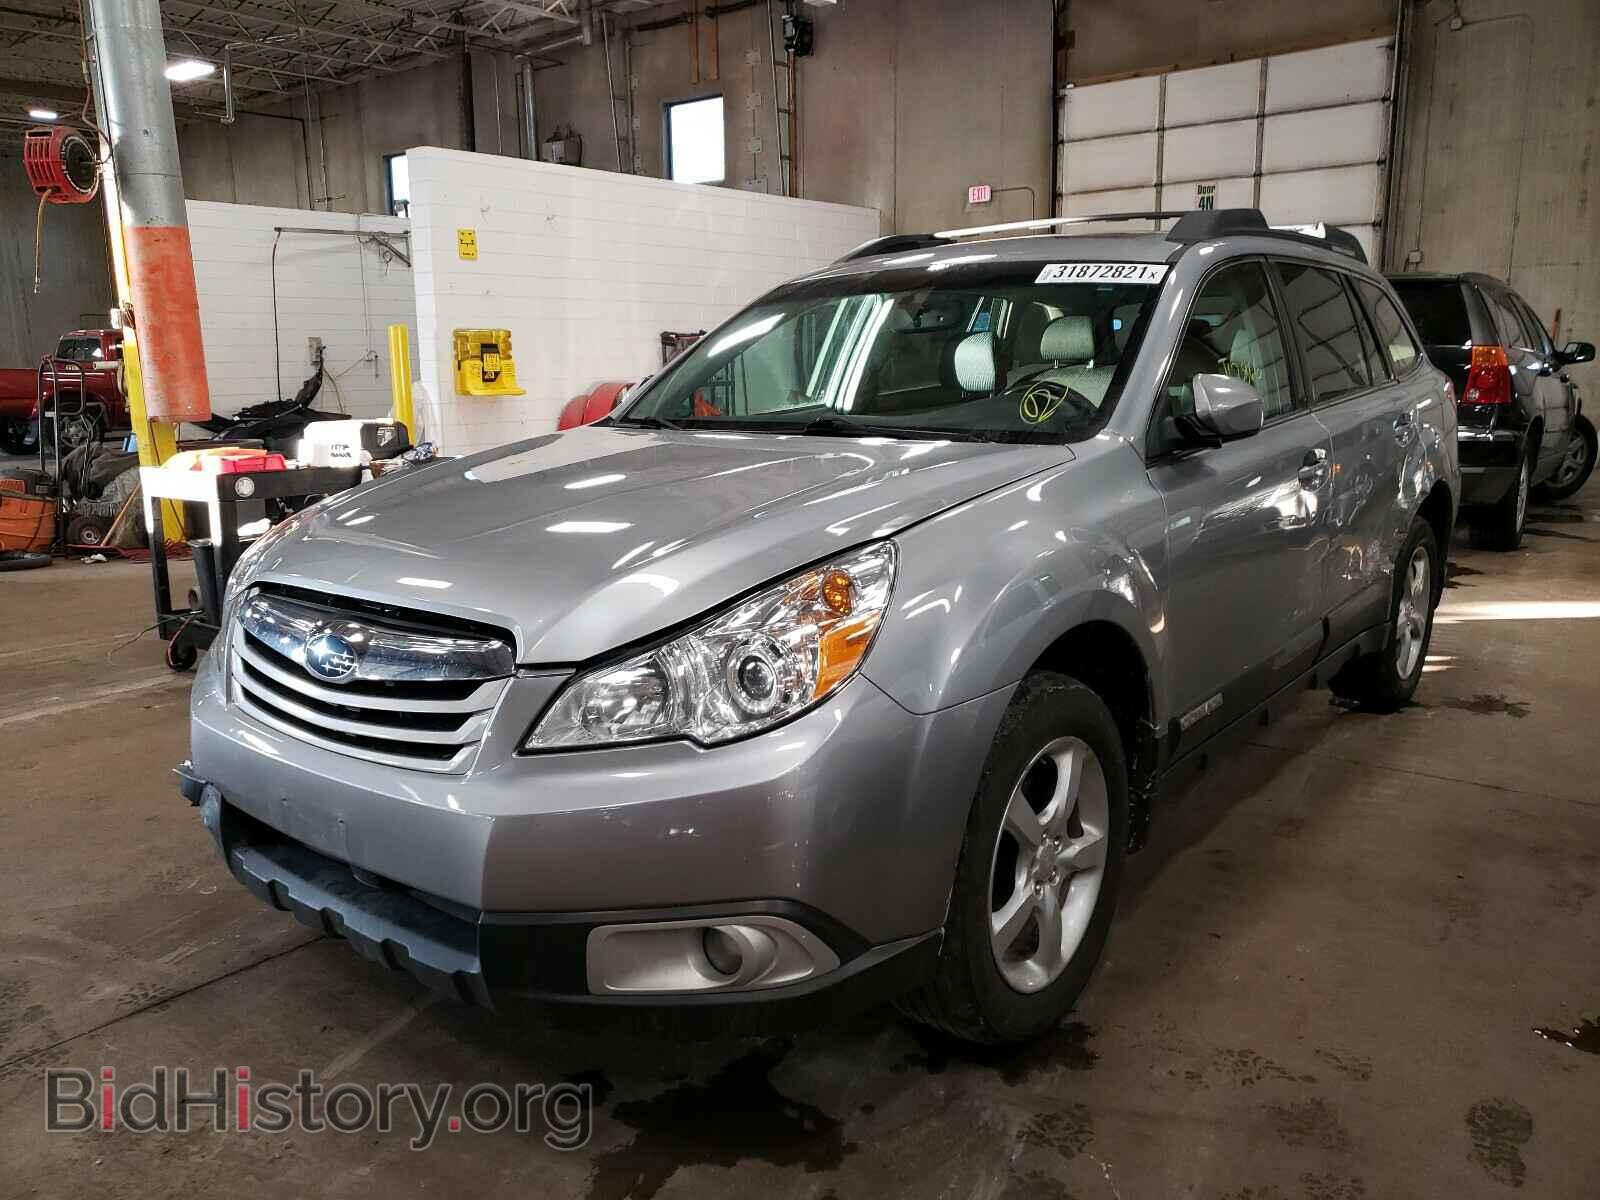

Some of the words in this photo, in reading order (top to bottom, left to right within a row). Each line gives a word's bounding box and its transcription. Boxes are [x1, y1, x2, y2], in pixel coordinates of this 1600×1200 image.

[972, 187, 987, 201] EXIT
[1197, 184, 1215, 194] Door
[1053, 265, 1148, 279] 31872821
